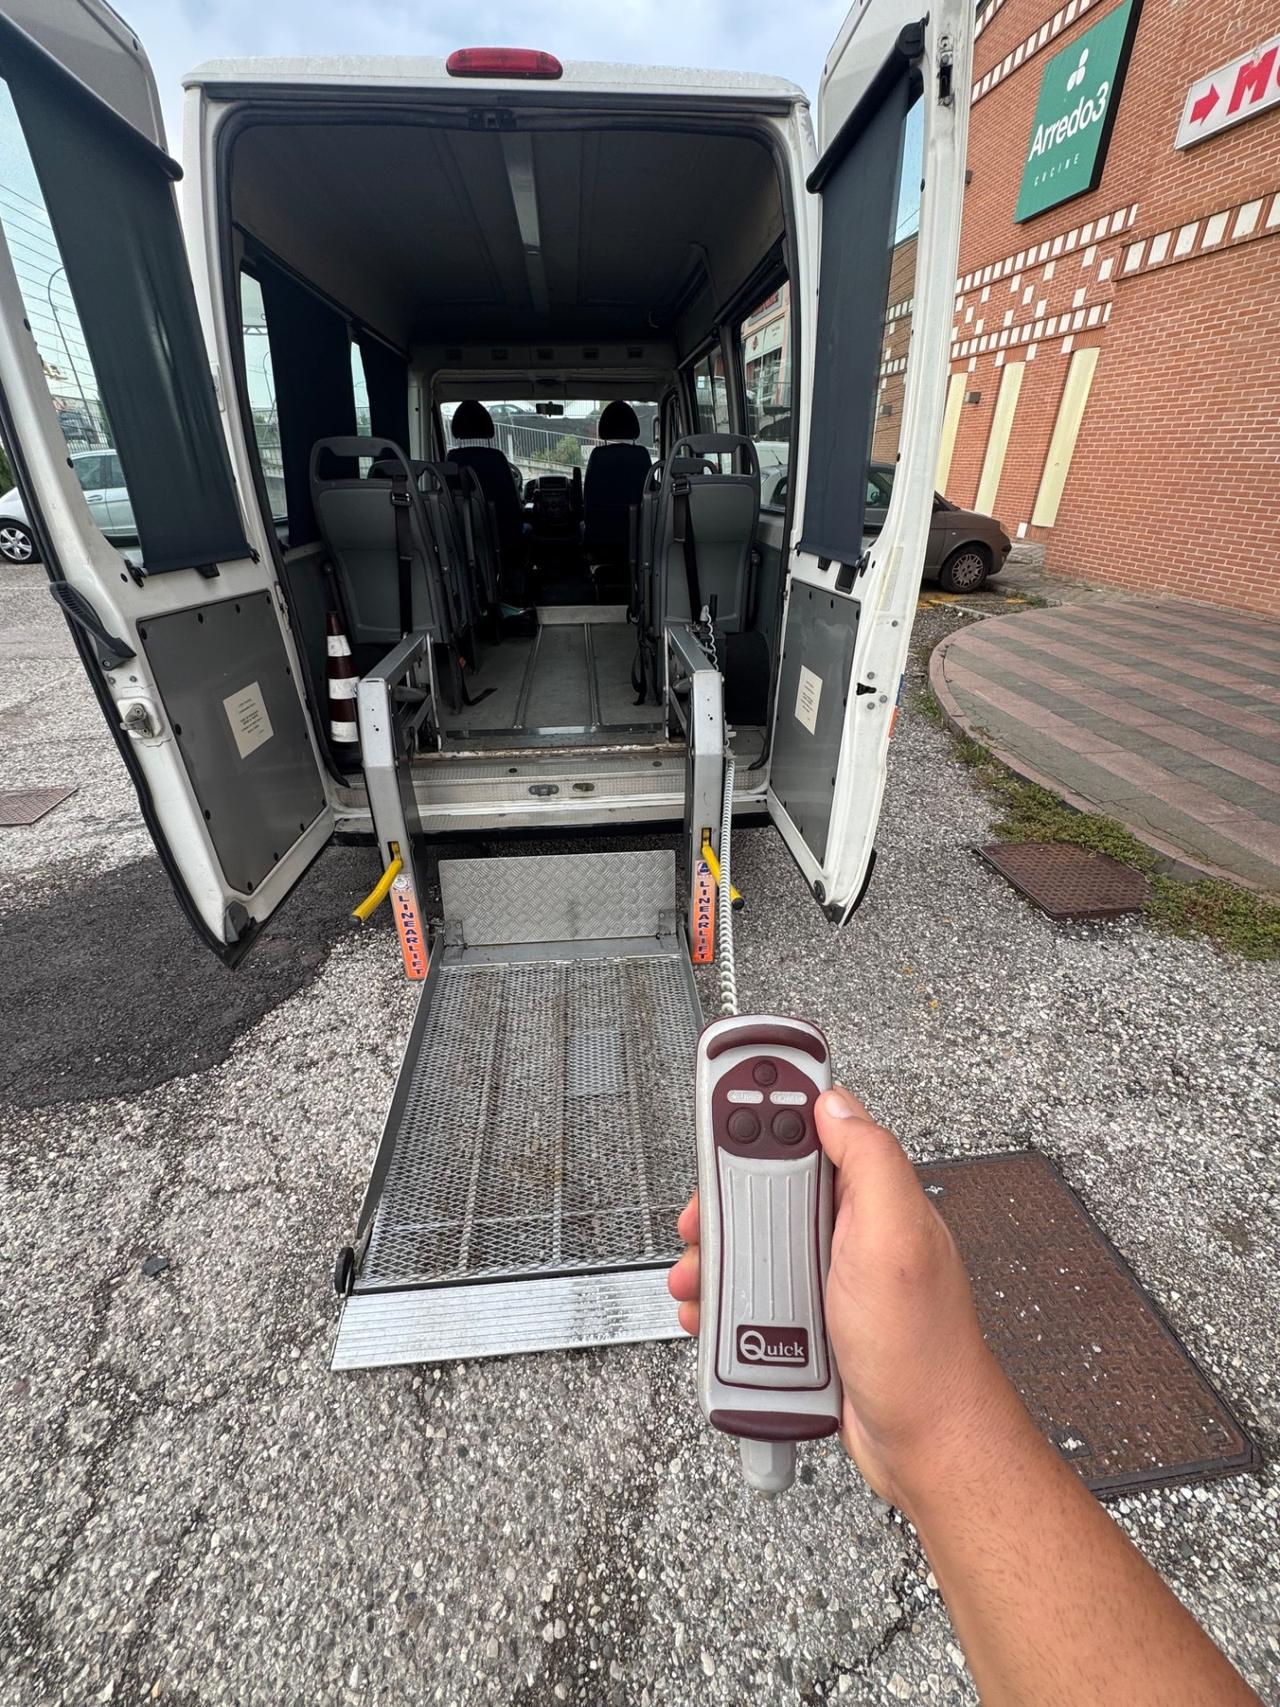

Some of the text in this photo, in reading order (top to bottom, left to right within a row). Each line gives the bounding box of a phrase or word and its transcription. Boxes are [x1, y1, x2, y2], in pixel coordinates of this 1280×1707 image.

[1226, 44, 1280, 116] M
[1028, 81, 1109, 162] Arredo3
[398, 895, 423, 975] LINEARLIFT
[698, 880, 711, 960] LINEARLIFT
[740, 1330, 806, 1362] Quick
